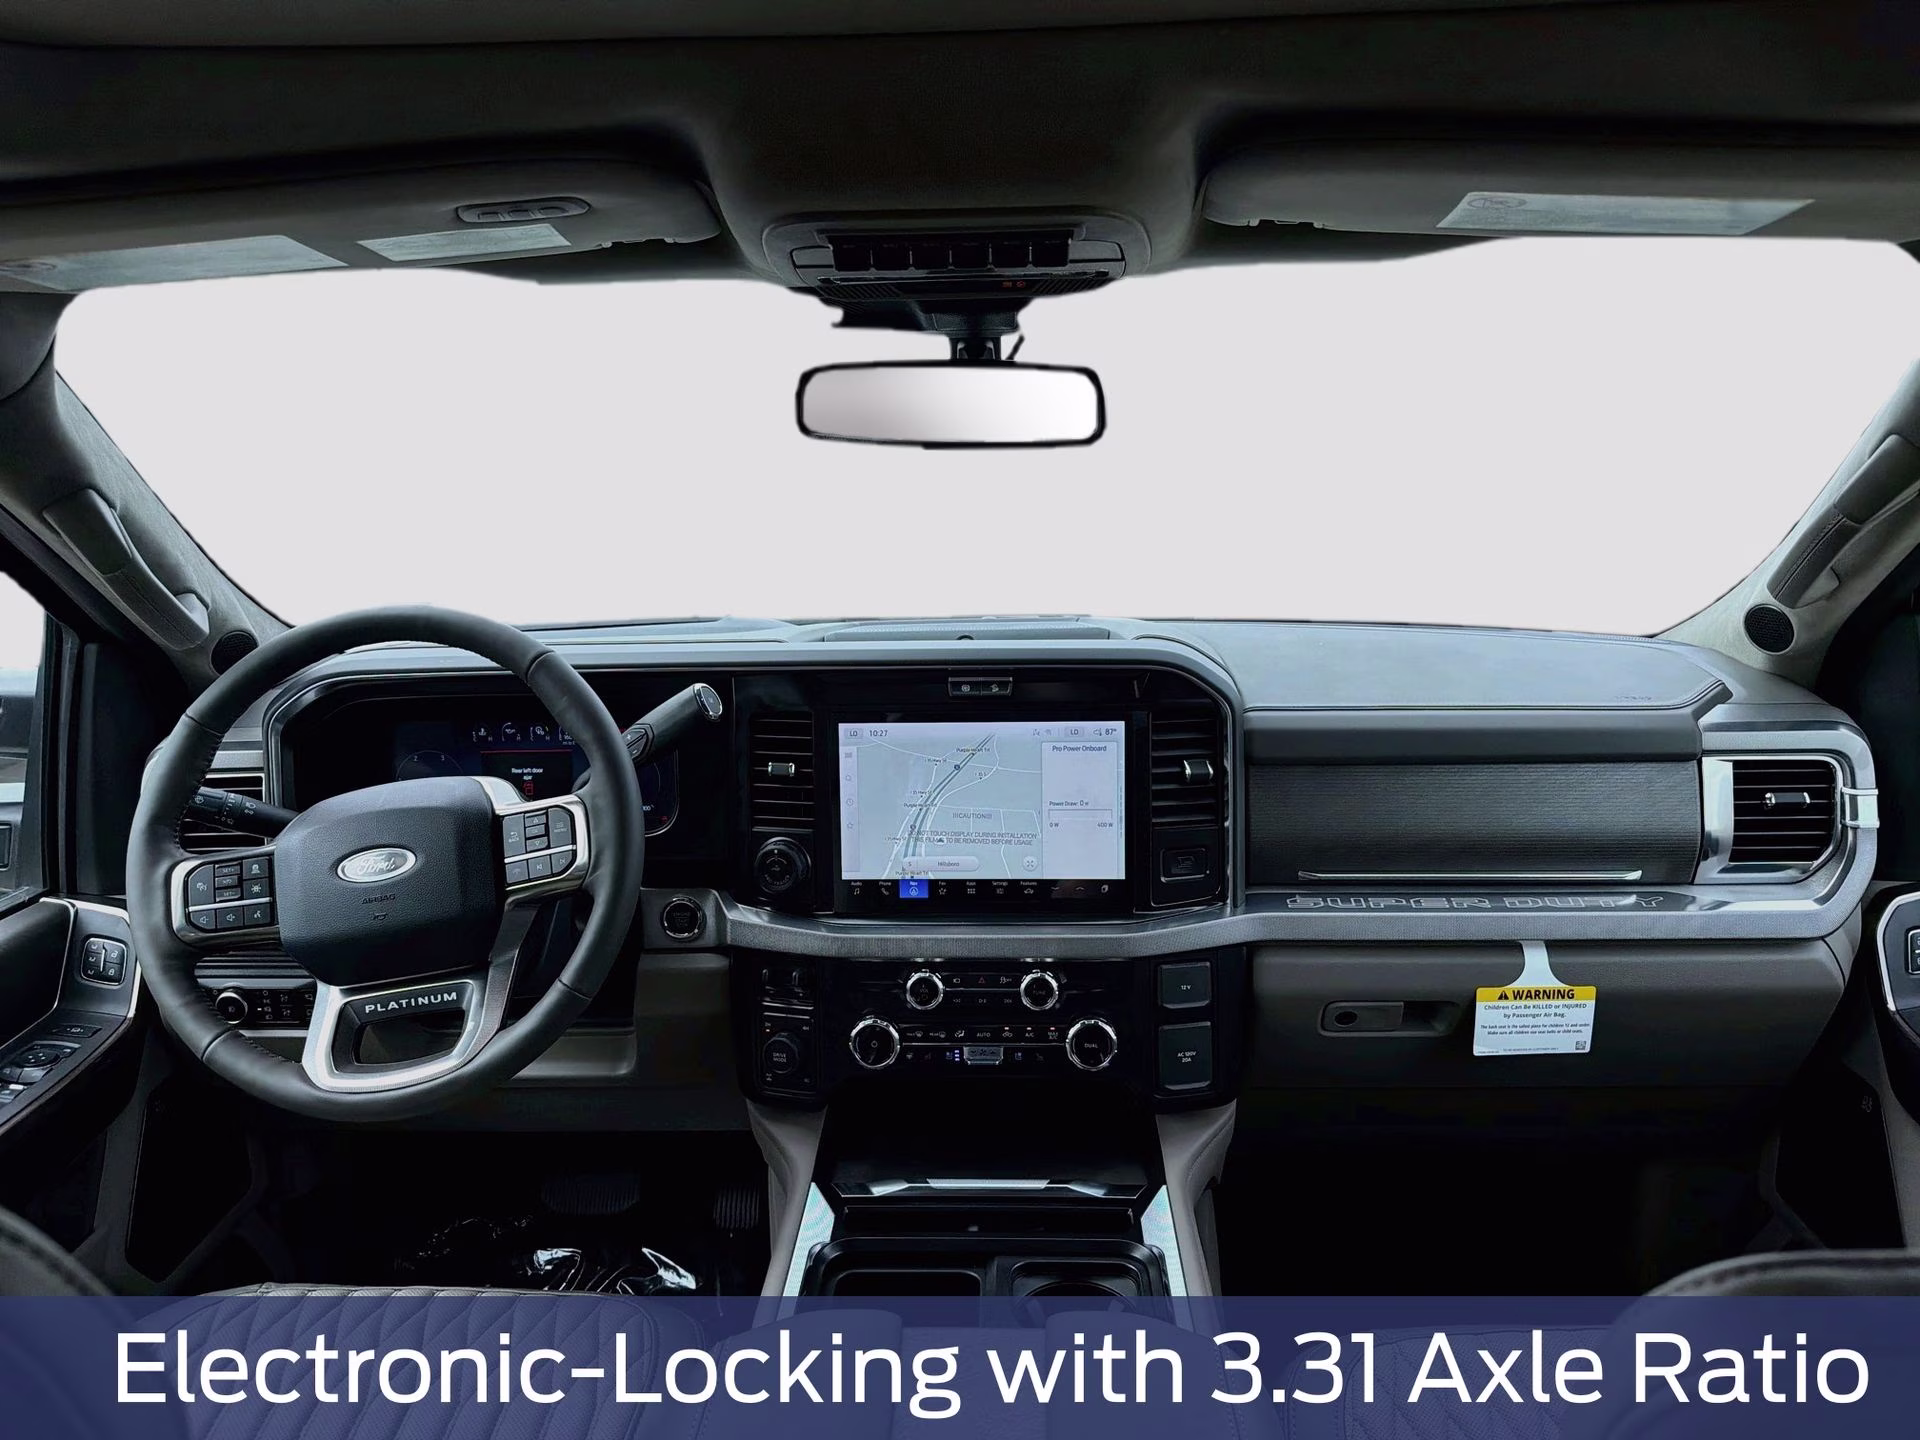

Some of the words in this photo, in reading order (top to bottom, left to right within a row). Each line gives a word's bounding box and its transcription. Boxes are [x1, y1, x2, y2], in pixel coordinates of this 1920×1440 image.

[1286, 896, 1492, 908] SUPER
[1504, 896, 1664, 908] DUTY
[1512, 989, 1575, 1000] WARNING
[365, 992, 457, 1013] PLATINUM
